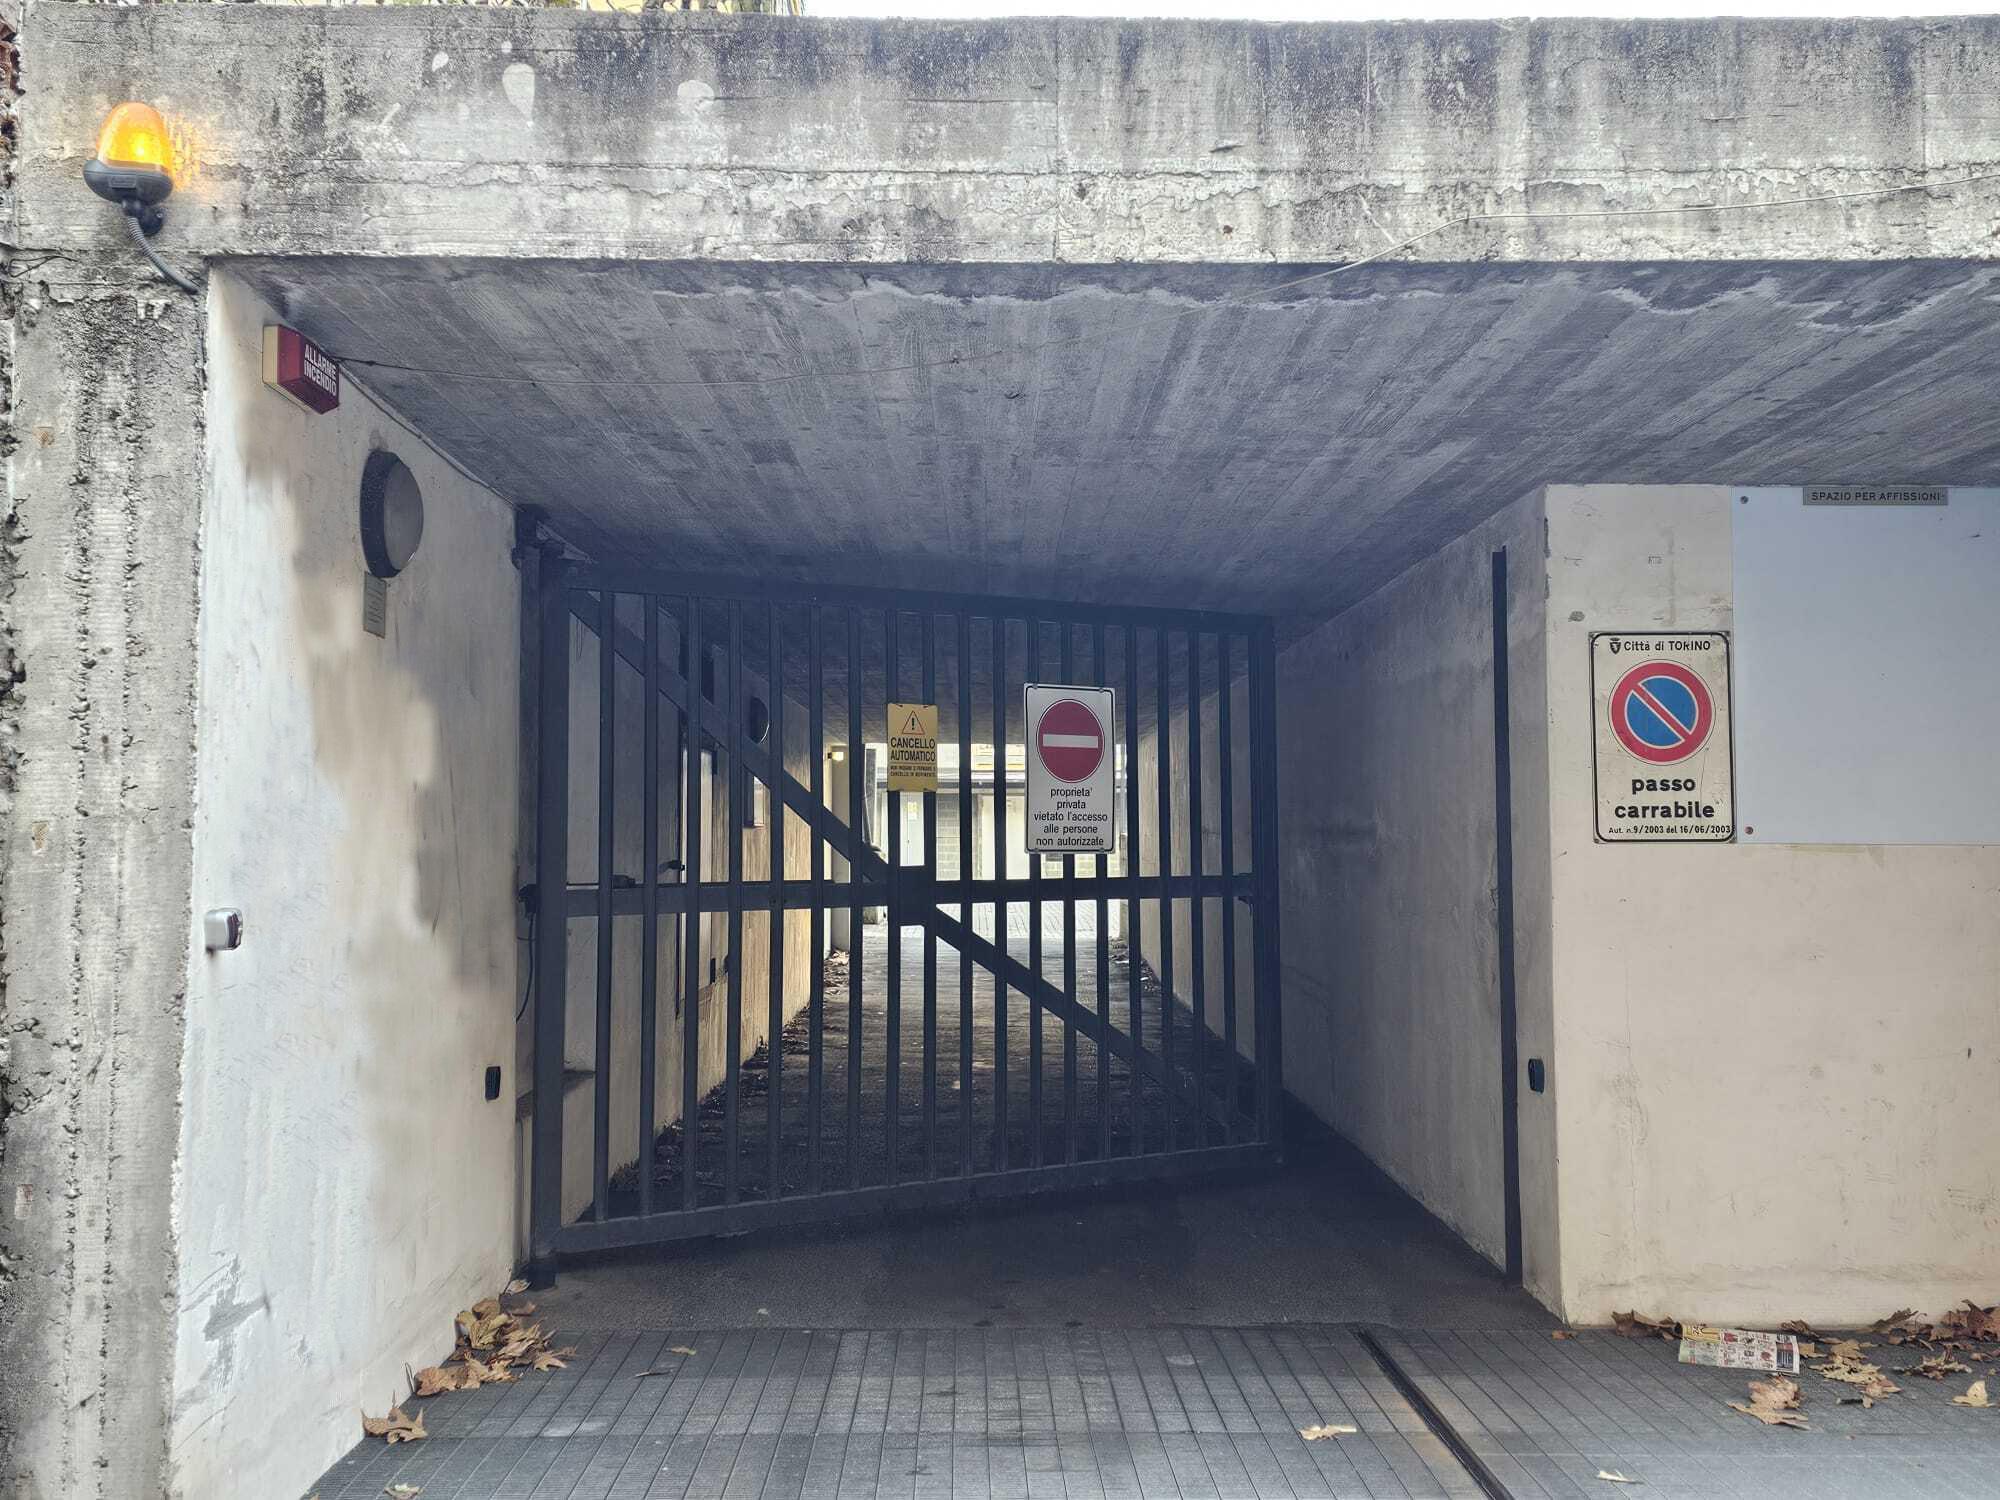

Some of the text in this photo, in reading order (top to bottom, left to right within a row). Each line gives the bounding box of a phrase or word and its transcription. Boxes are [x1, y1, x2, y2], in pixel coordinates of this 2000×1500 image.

[304, 344, 337, 380] ALLARME
[303, 360, 337, 396] INCENDIO
[1811, 492, 1940, 501] SPAZIO PER AFFISSIONI
[1623, 640, 1711, 651] Città di TORINO
[890, 737, 936, 749] CANCELLO
[890, 749, 936, 762] AUTOMATICO
[1631, 778, 1697, 795] passo
[1050, 787, 1093, 799] proprieta'
[1056, 799, 1086, 810] privata
[1614, 801, 1715, 818] carrabile
[1034, 811, 1108, 821] vietato l'accesso
[1043, 823, 1098, 835] alle persone
[1666, 826, 1677, 834] del
[1680, 825, 1731, 834] 16/06/2003
[1036, 836, 1104, 846] non autorizzate
